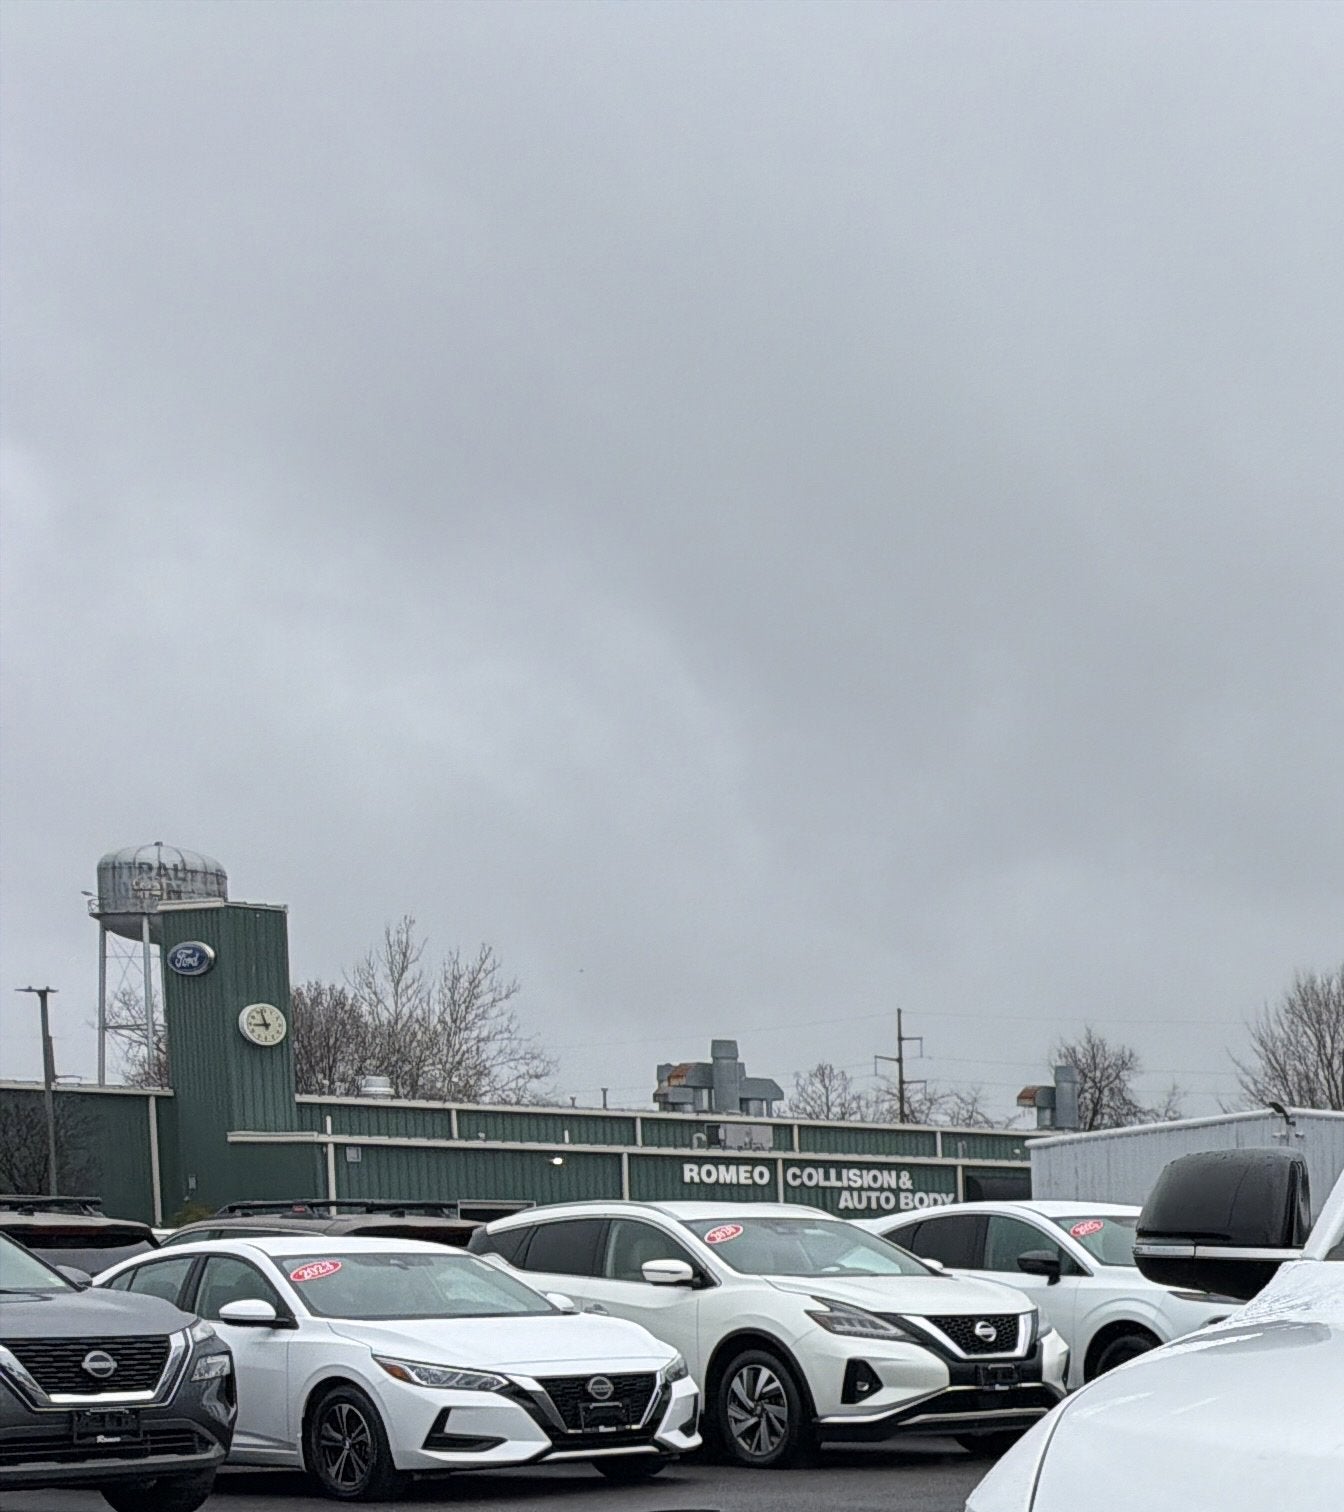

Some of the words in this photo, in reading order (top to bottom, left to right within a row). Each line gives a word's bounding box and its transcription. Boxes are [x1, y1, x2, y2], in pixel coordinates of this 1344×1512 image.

[174, 949, 201, 968] Ford
[683, 1163, 771, 1186] ROMEO
[786, 1167, 897, 1190] COLLISION
[898, 1170, 913, 1190] &
[838, 1190, 896, 1210] AUTO
